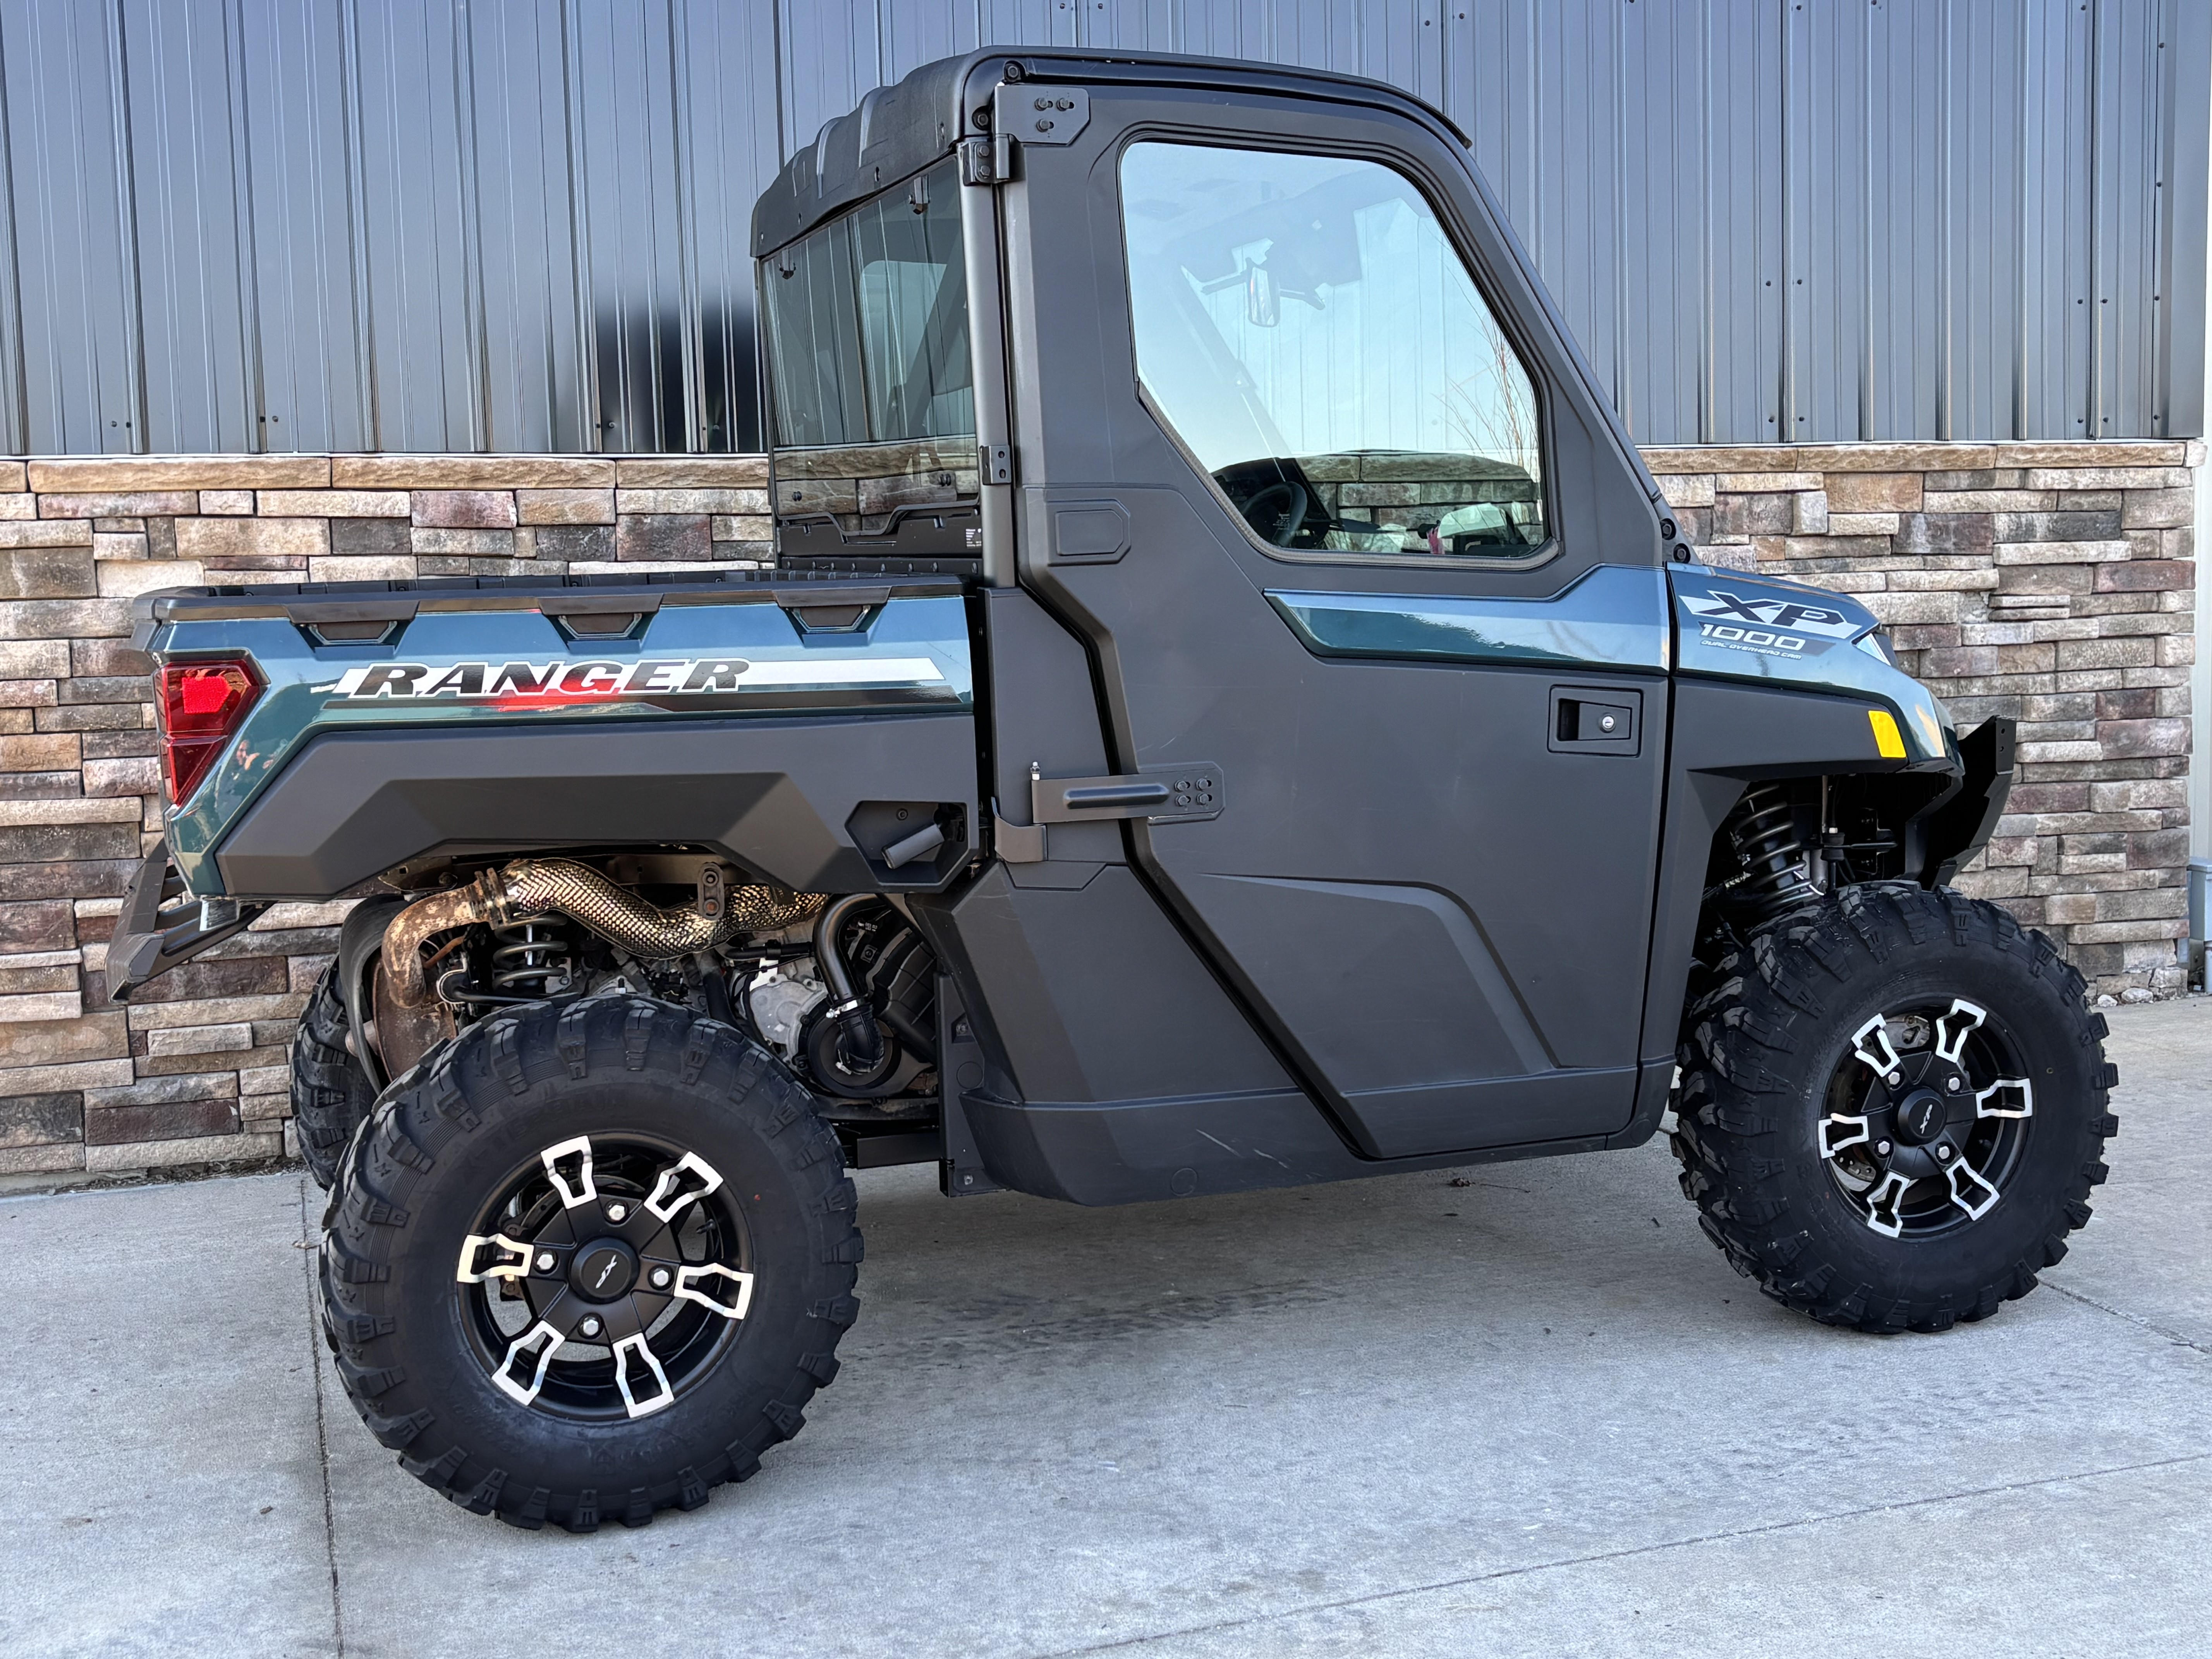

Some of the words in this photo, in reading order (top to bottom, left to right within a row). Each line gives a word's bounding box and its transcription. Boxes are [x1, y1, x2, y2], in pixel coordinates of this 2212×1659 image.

[1693, 591, 1846, 627] XP
[1700, 623, 1806, 651] 1000
[1701, 640, 1727, 648] DUAL
[1729, 644, 1780, 656] OVERHEAD
[1781, 652, 1802, 660] CAM
[349, 658, 750, 699] RANGER
